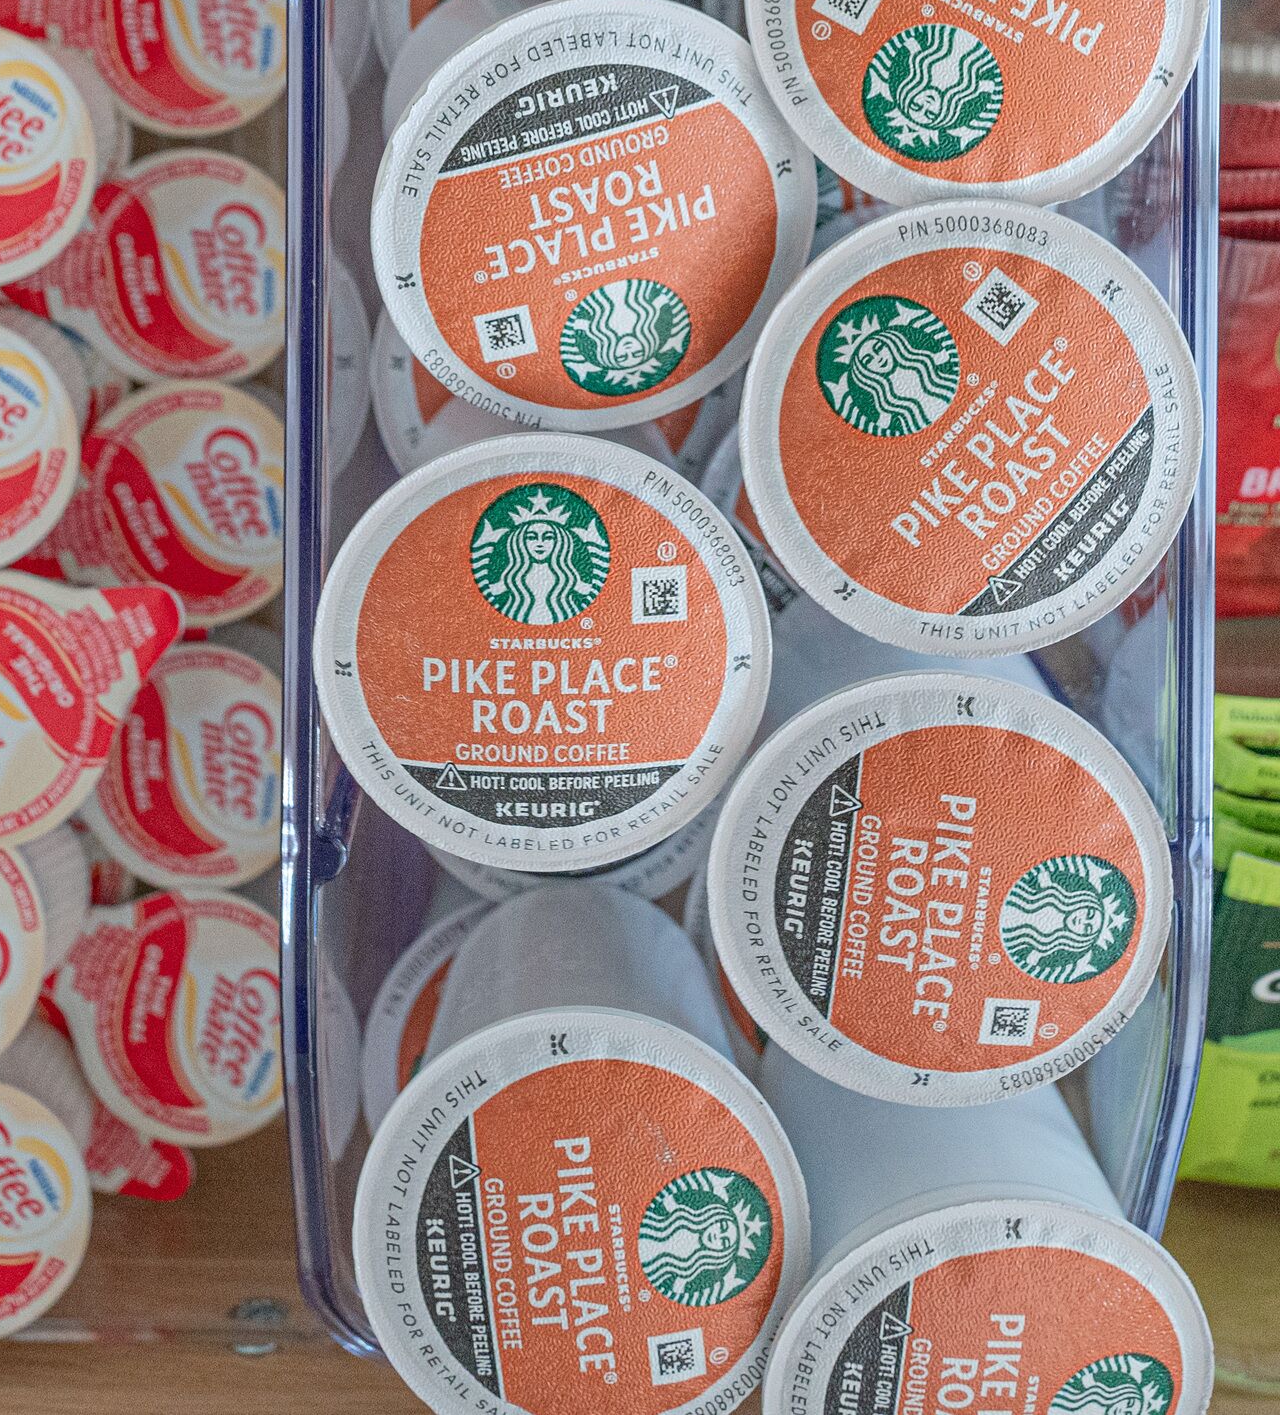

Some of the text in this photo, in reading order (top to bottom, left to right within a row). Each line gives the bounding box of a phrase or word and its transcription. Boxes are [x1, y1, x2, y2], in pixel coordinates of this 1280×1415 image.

[515, 73, 619, 118] KEURIG
[489, 185, 717, 281] PIKE PLACE
[530, 160, 663, 231] ROAST
[898, 215, 1050, 246] P/N 5000368083
[557, 245, 660, 285] STARBUCKS
[890, 350, 1076, 547] PIKE PLACE
[921, 385, 995, 468] STARBUCKS
[956, 414, 1072, 541] ROAST
[981, 432, 1109, 571] GROUND COFFEE
[1014, 431, 1149, 580] HOT! COOL BEFORE PEELING
[644, 471, 745, 588] P/N 5000368083
[1053, 493, 1131, 582] KEURIG
[424, 656, 661, 695] PIKE PLACE
[489, 637, 593, 650] STARBUCKS
[455, 743, 630, 763] GROUND COFFEE
[472, 699, 613, 735] ROAST
[361, 740, 724, 852] THIS UNIT NOT LABELED FOR RETAIL SALE
[471, 770, 660, 791] HOT! COOL BEFORE PEELING
[495, 801, 601, 818] KEURIG
[783, 839, 813, 940] KEURIG
[877, 837, 929, 973] ROAST
[912, 794, 977, 1018] PIKE PLACE
[426, 1218, 457, 1322] KEURIG
[517, 1193, 569, 1332] ROAST
[554, 1136, 617, 1374] PIKE PLACE
[979, 1313, 1026, 1398] PIKE
